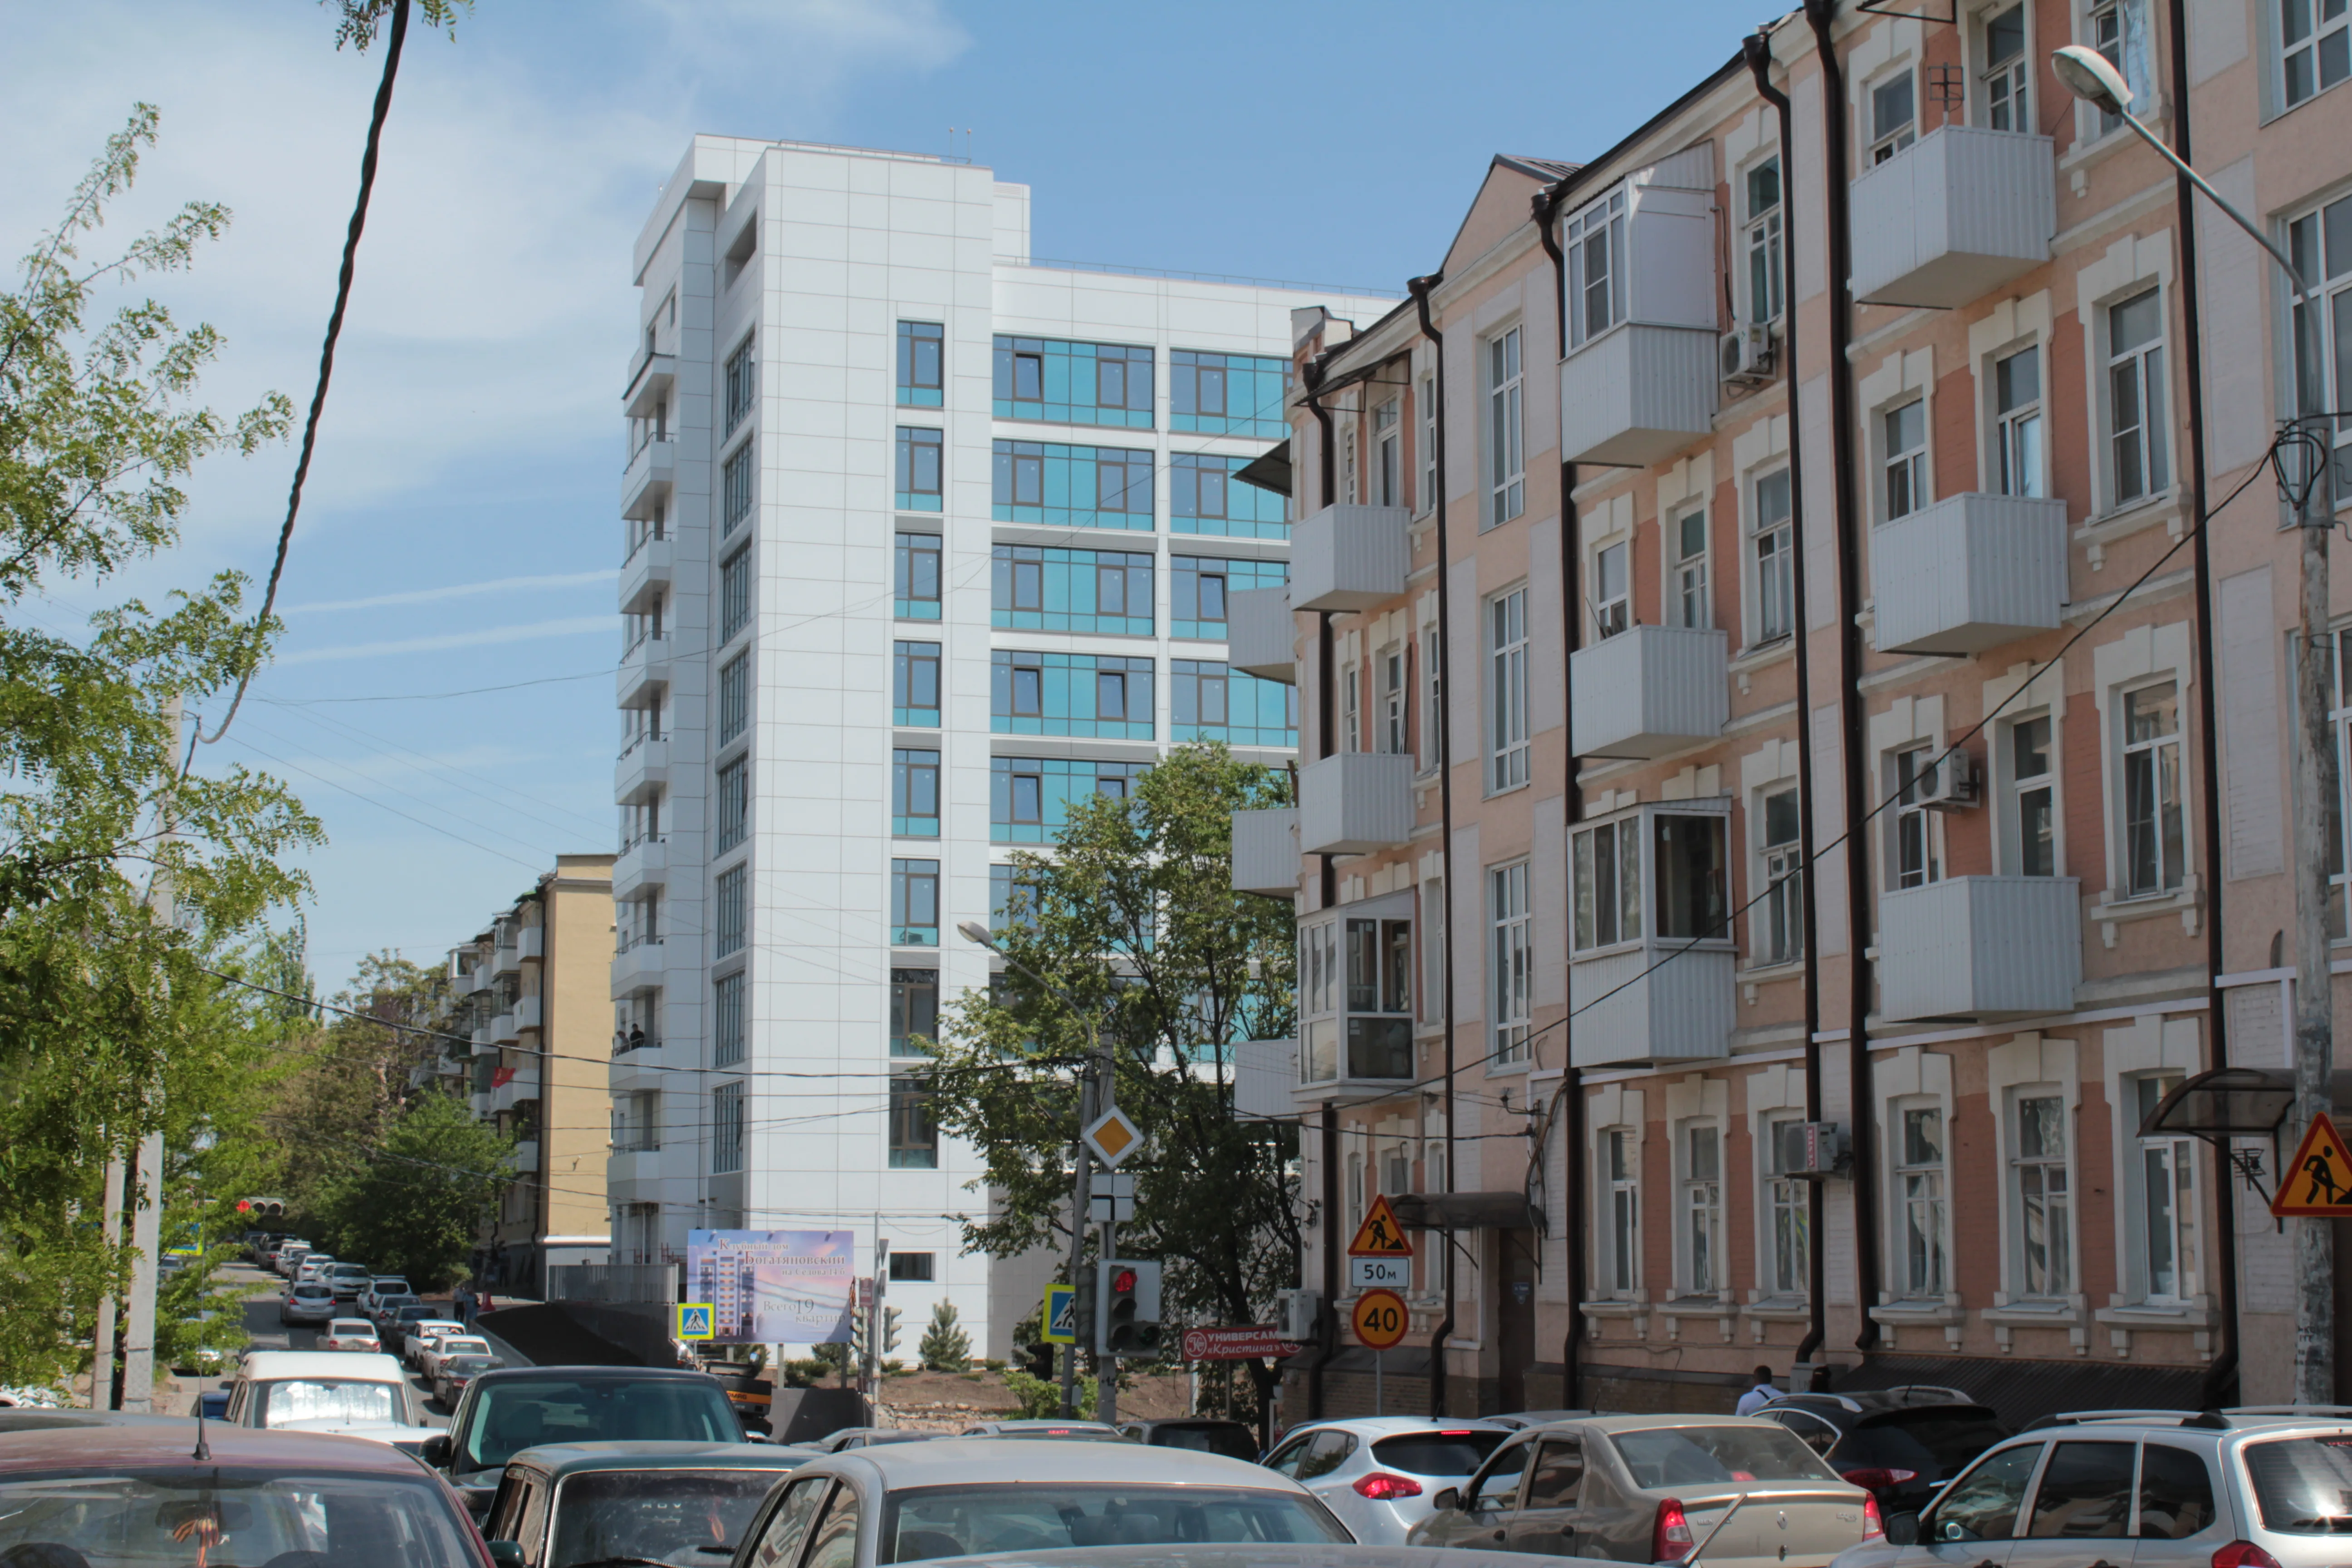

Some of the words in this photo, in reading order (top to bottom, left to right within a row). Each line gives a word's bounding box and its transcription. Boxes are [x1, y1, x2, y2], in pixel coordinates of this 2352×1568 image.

[720, 1239, 768, 1251] Клубный
[745, 1250, 845, 1265] Богатяновский
[764, 1300, 796, 1311] Всего
[795, 1298, 814, 1314] 19
[796, 1315, 846, 1326] квартир
[1363, 1307, 1398, 1332] 40
[1207, 1331, 1278, 1342] УНИВЕРСАМ
[1207, 1343, 1280, 1357] «Кристина»
